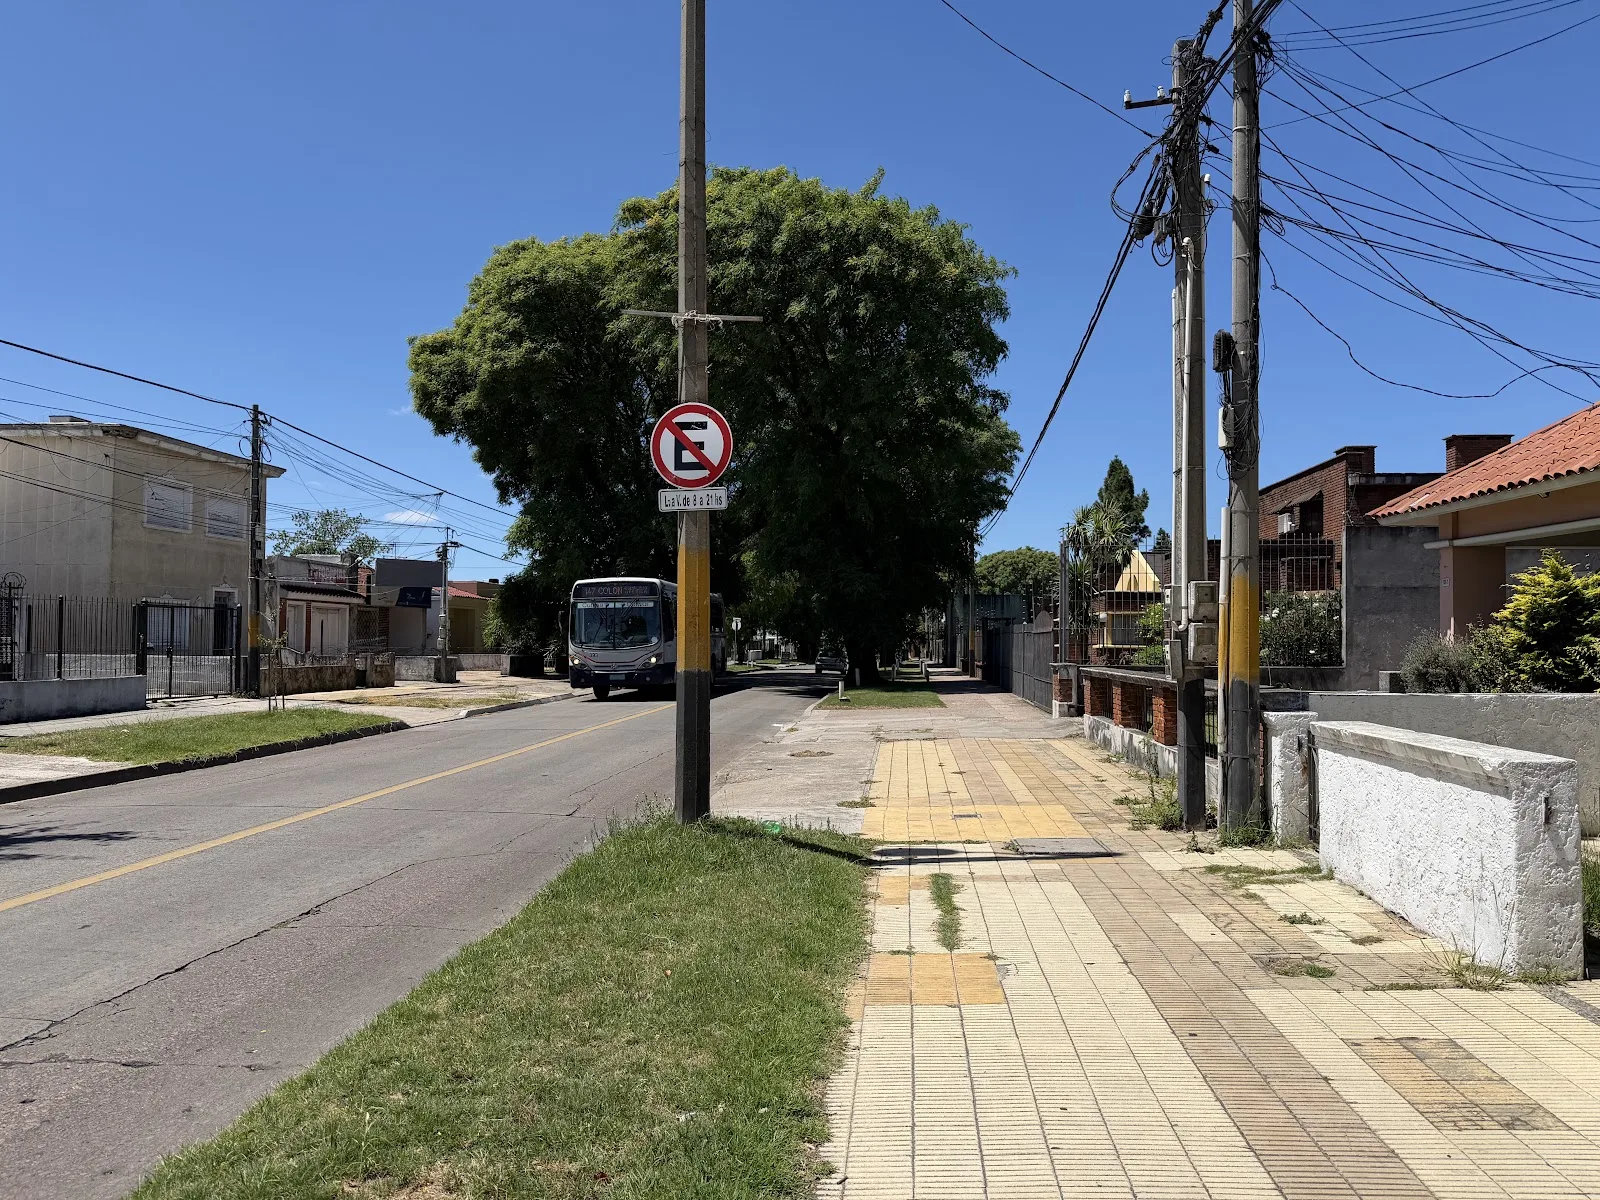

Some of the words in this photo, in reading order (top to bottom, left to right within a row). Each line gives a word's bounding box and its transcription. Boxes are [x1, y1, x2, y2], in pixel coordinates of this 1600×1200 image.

[675, 422, 708, 470] E
[692, 494, 697, 507] 8
[700, 496, 704, 506] a
[706, 493, 713, 506] 21
[714, 493, 723, 506] hs
